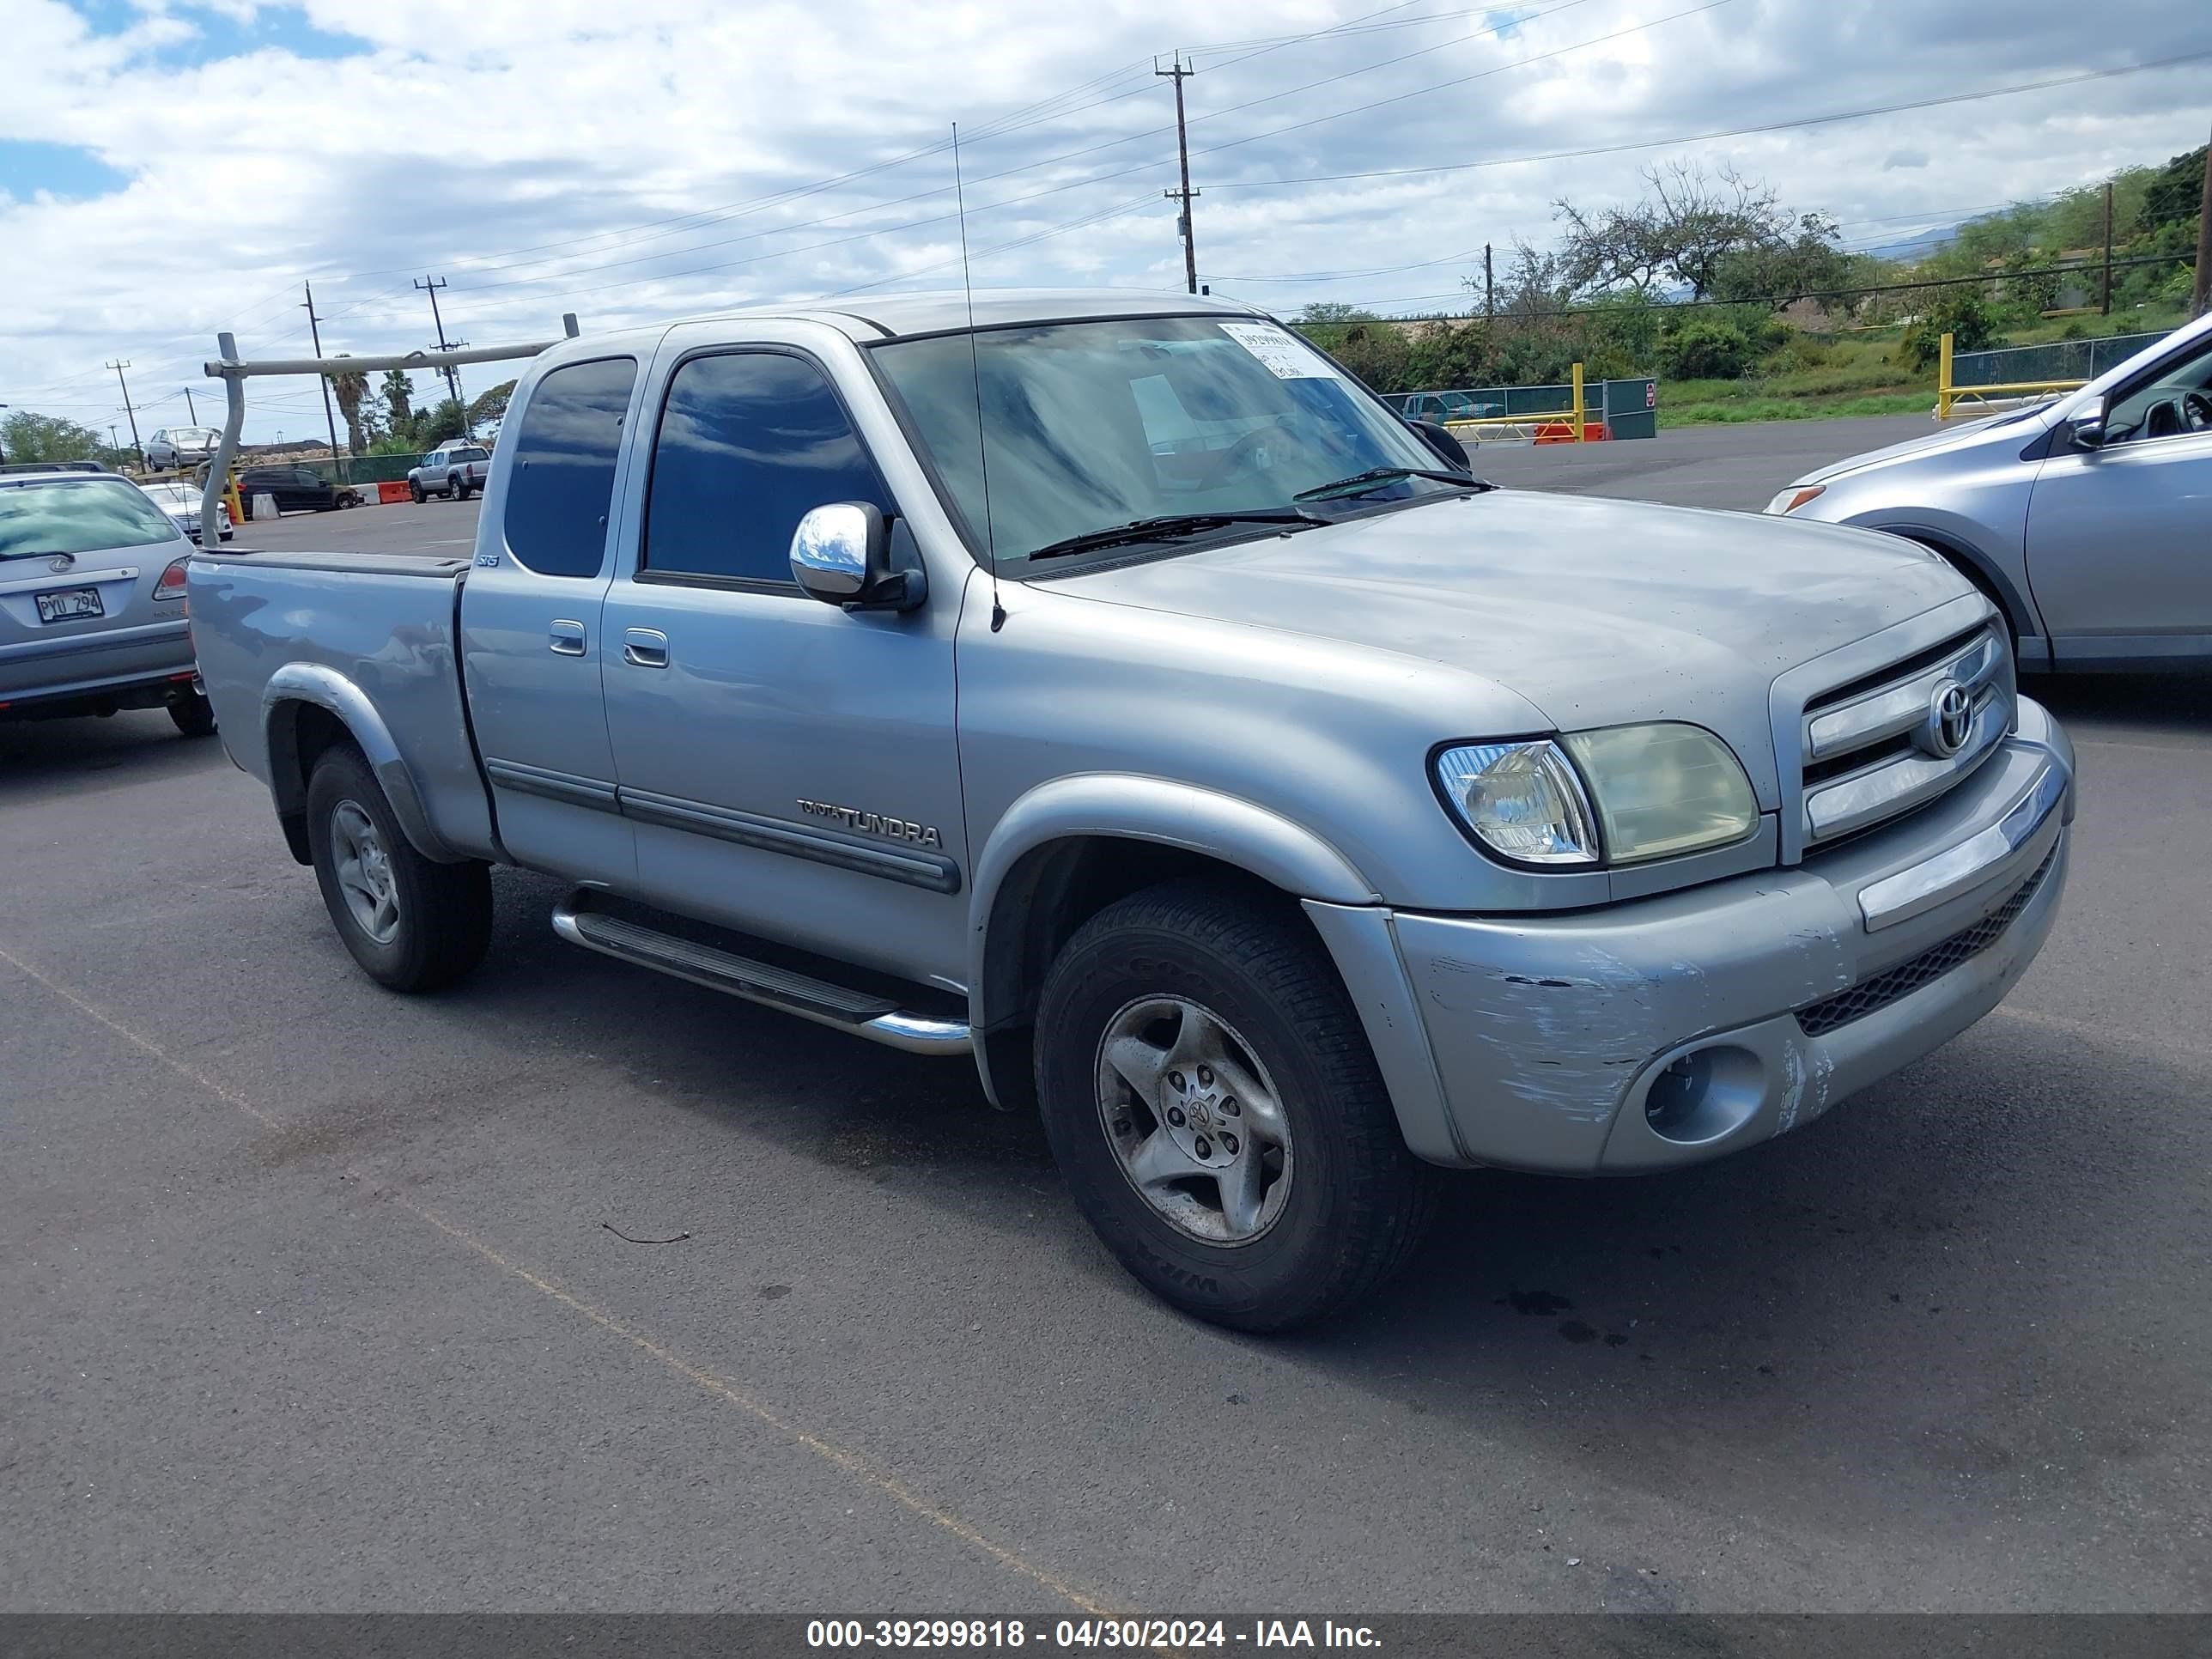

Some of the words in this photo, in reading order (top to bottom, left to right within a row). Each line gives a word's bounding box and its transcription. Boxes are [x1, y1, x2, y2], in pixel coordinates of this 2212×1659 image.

[40, 599, 66, 617] PYU
[74, 595, 100, 612] 294
[796, 799, 840, 818] TOYOTA
[839, 808, 943, 848] TUNDRA
